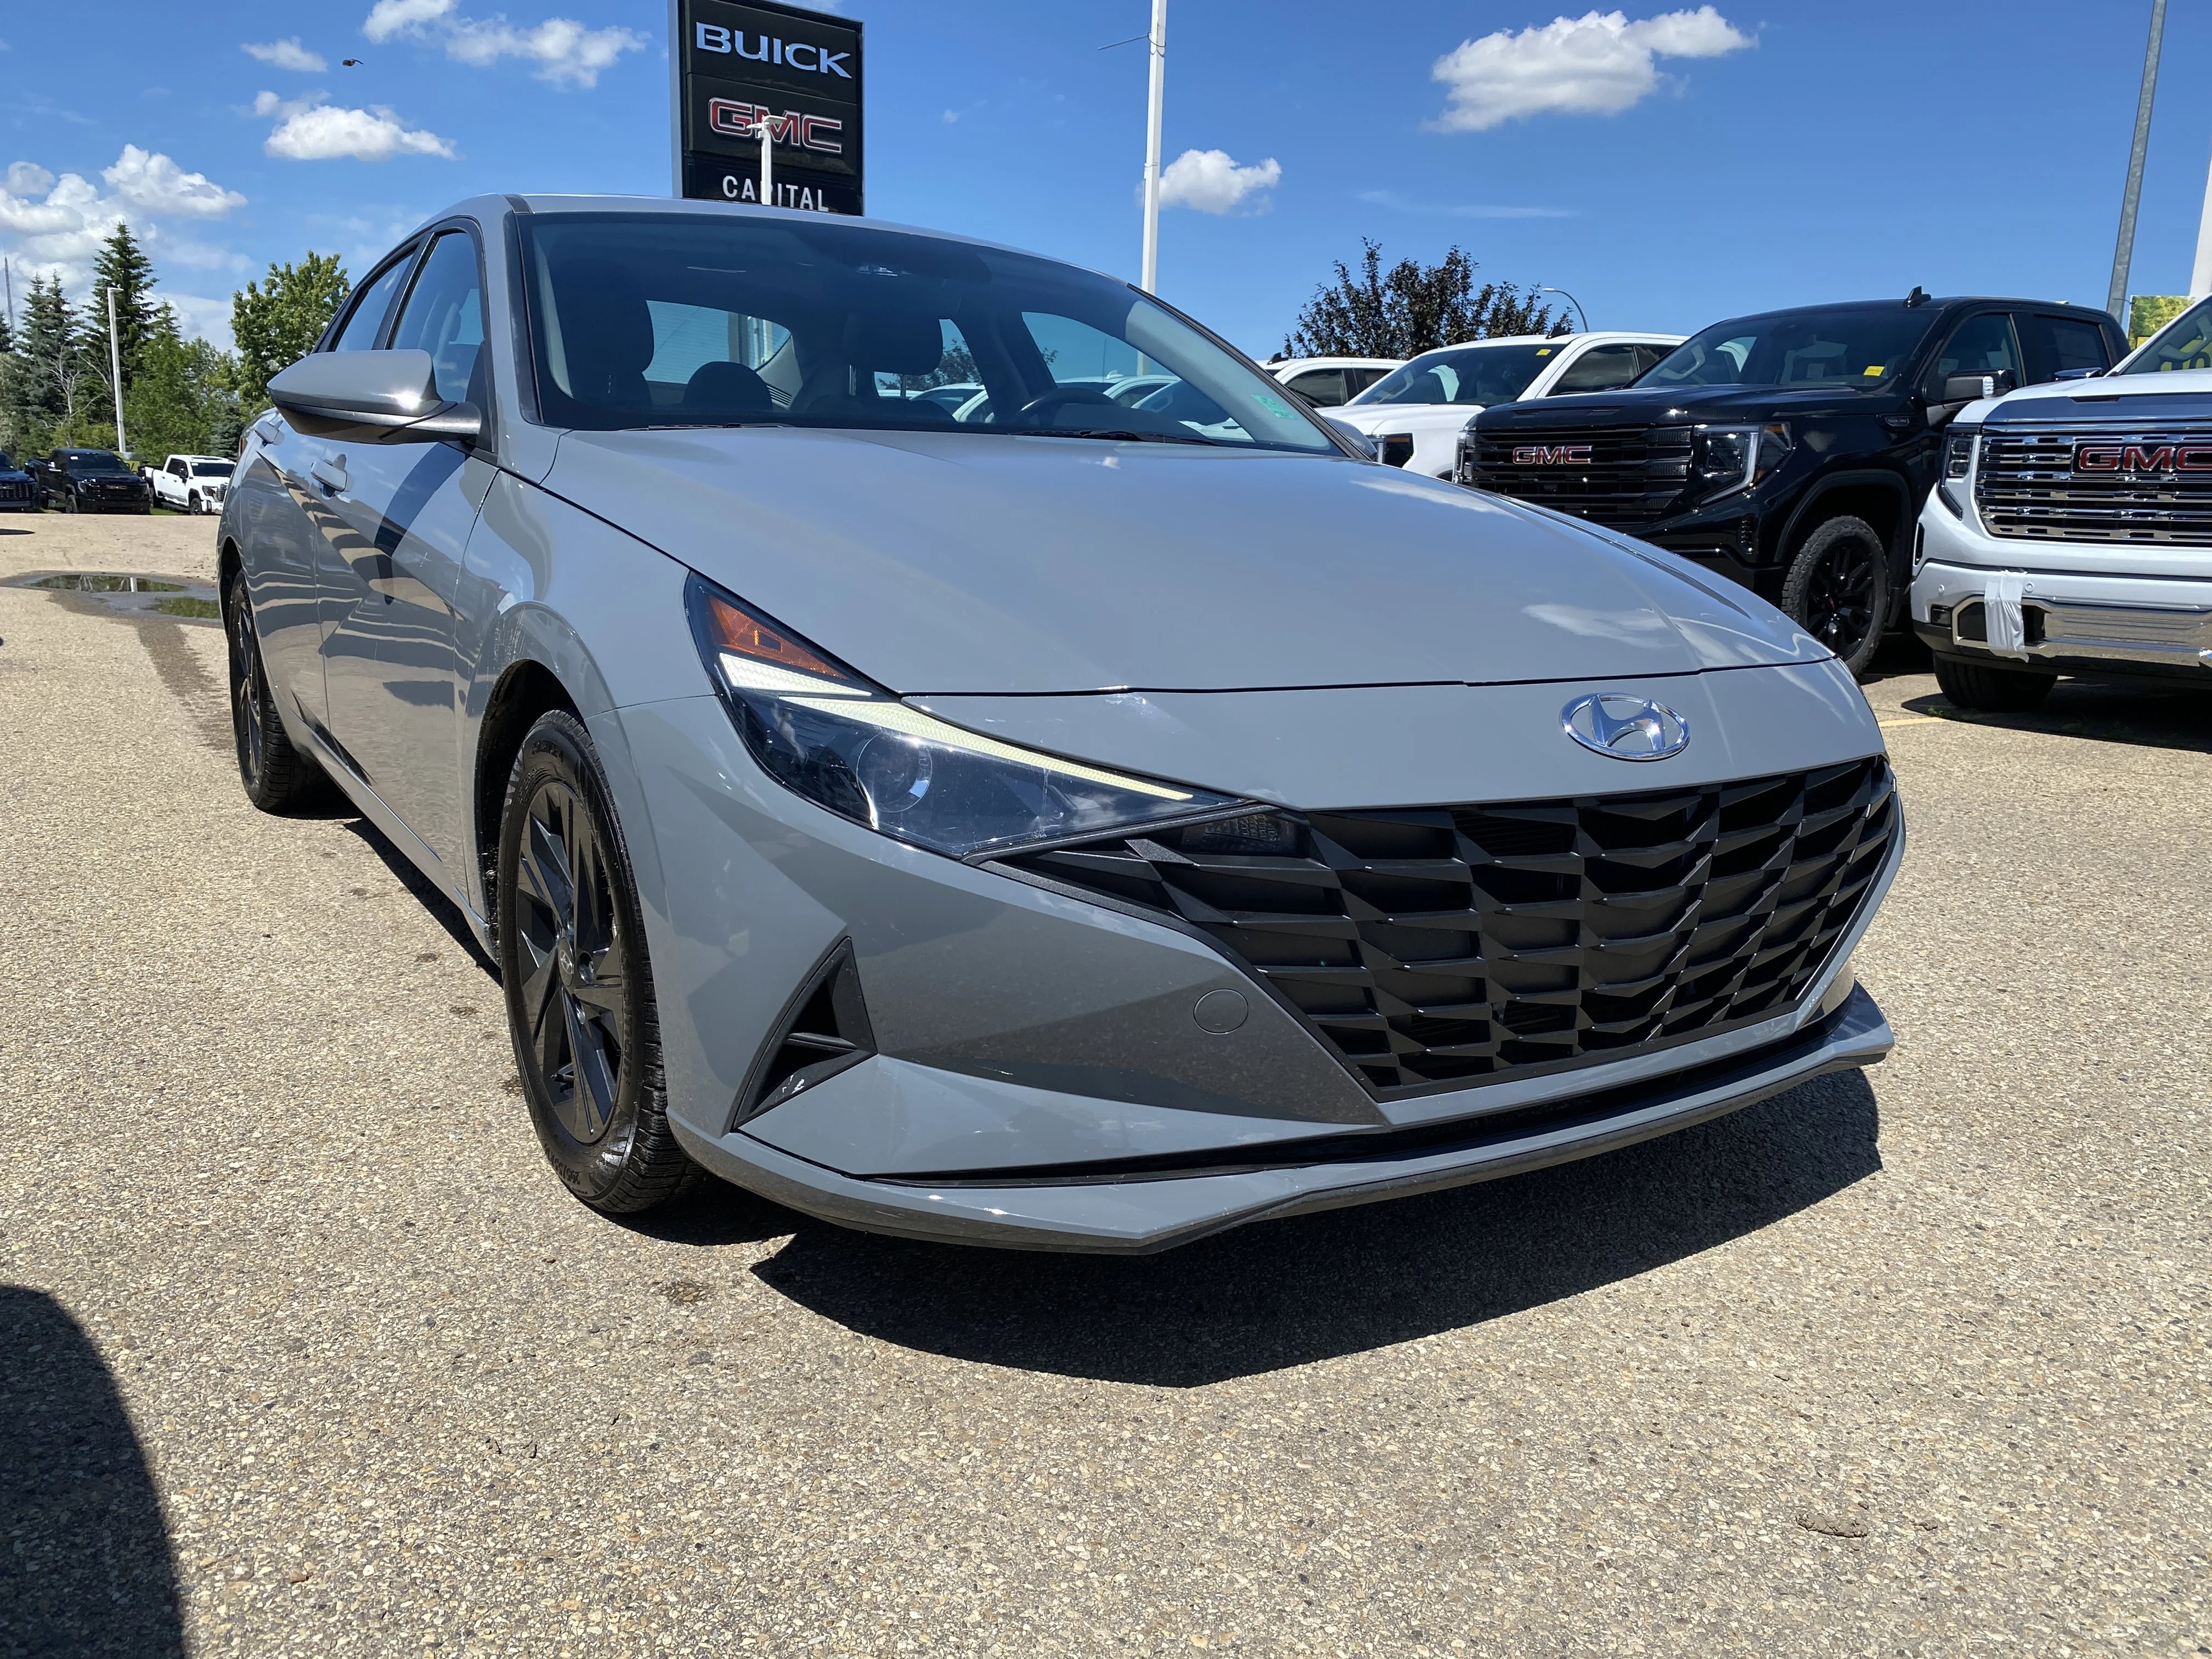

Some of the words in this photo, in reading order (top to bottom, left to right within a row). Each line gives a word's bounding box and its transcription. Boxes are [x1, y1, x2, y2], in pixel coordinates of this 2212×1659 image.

[696, 21, 853, 78] BUICK
[708, 97, 842, 154] GMC
[1513, 445, 1592, 465] GMC
[2079, 446, 2212, 471] GMC
